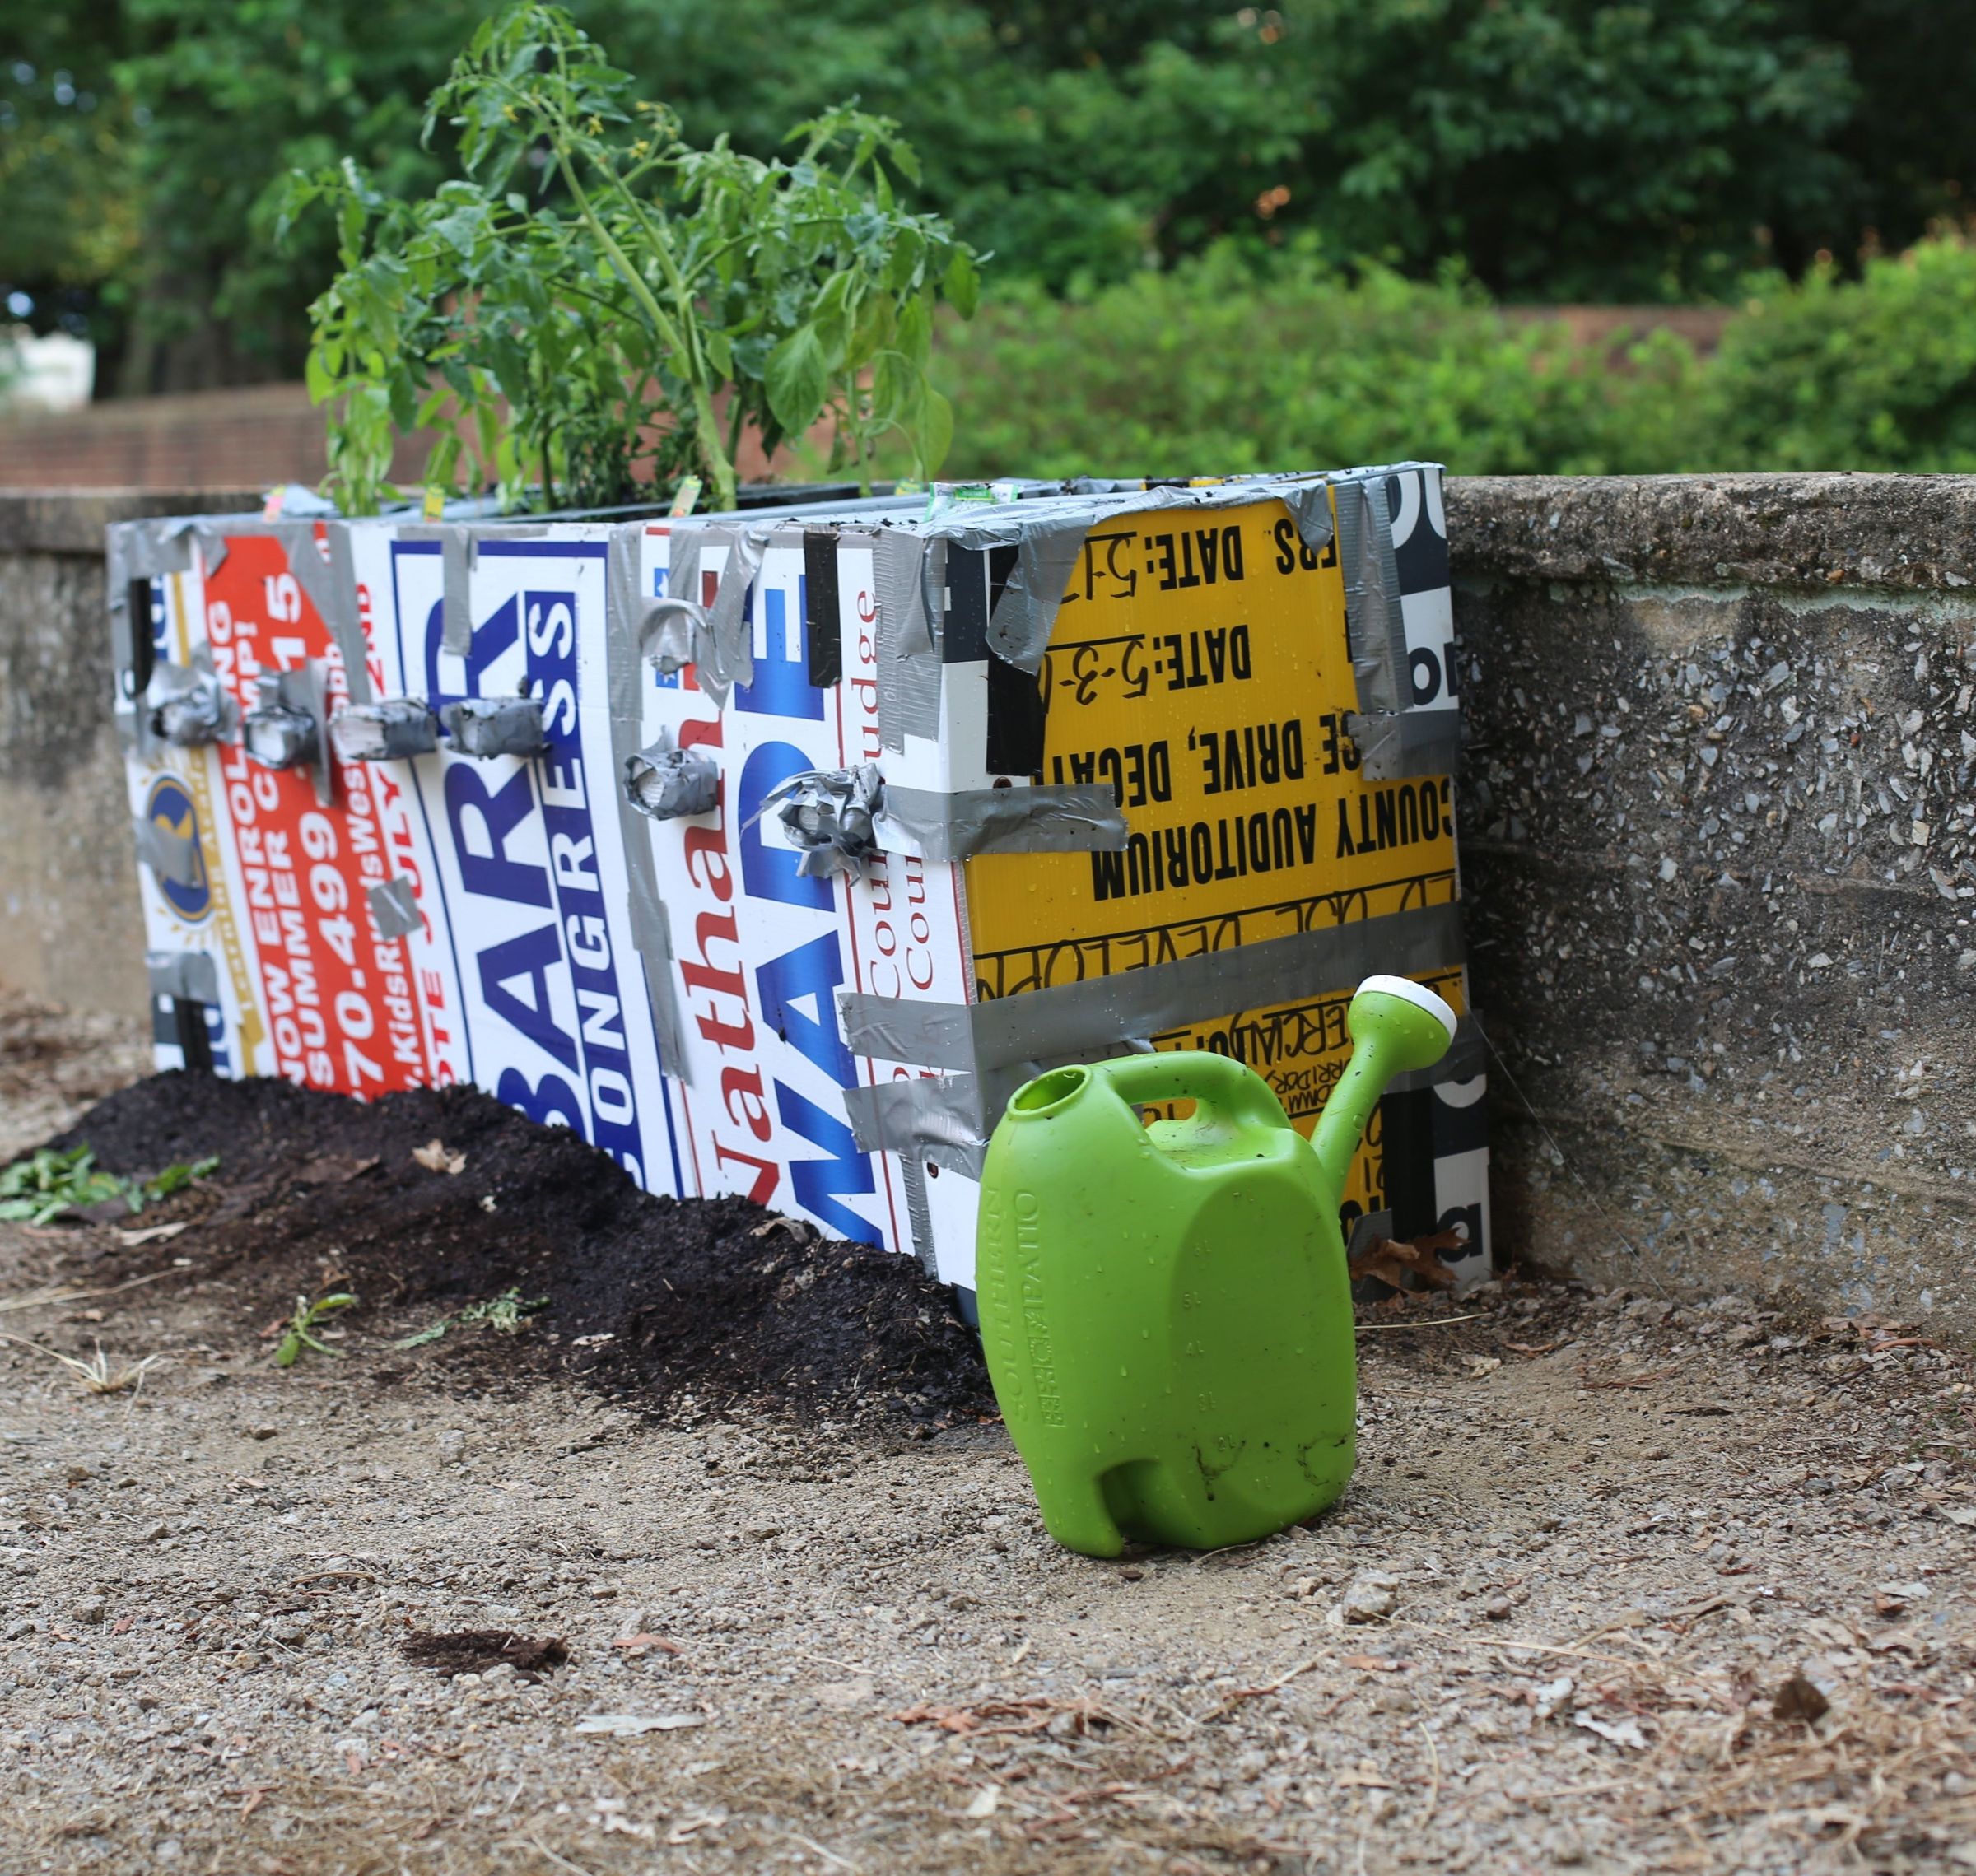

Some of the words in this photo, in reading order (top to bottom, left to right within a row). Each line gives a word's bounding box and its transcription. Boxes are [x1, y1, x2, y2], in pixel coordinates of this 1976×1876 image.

[1060, 537, 1137, 603] 5-1
[1146, 525, 1245, 590] DATE:
[851, 589, 883, 762] udge
[1154, 624, 1251, 691] DATE:
[1037, 740, 1173, 808] DECAT
[1187, 719, 1303, 795] DRIVE,
[1093, 803, 1317, 901] AUDITORIUM
[1335, 775, 1453, 859] COUNTY
[423, 589, 588, 1146] BARR
[733, 574, 884, 1251] WADE
[263, 829, 335, 1087] SUMMER
[422, 967, 456, 1092] OTE
[1228, 1004, 1353, 1067] ERCIAL)
[1013, 1188, 1045, 1308] PATIO
